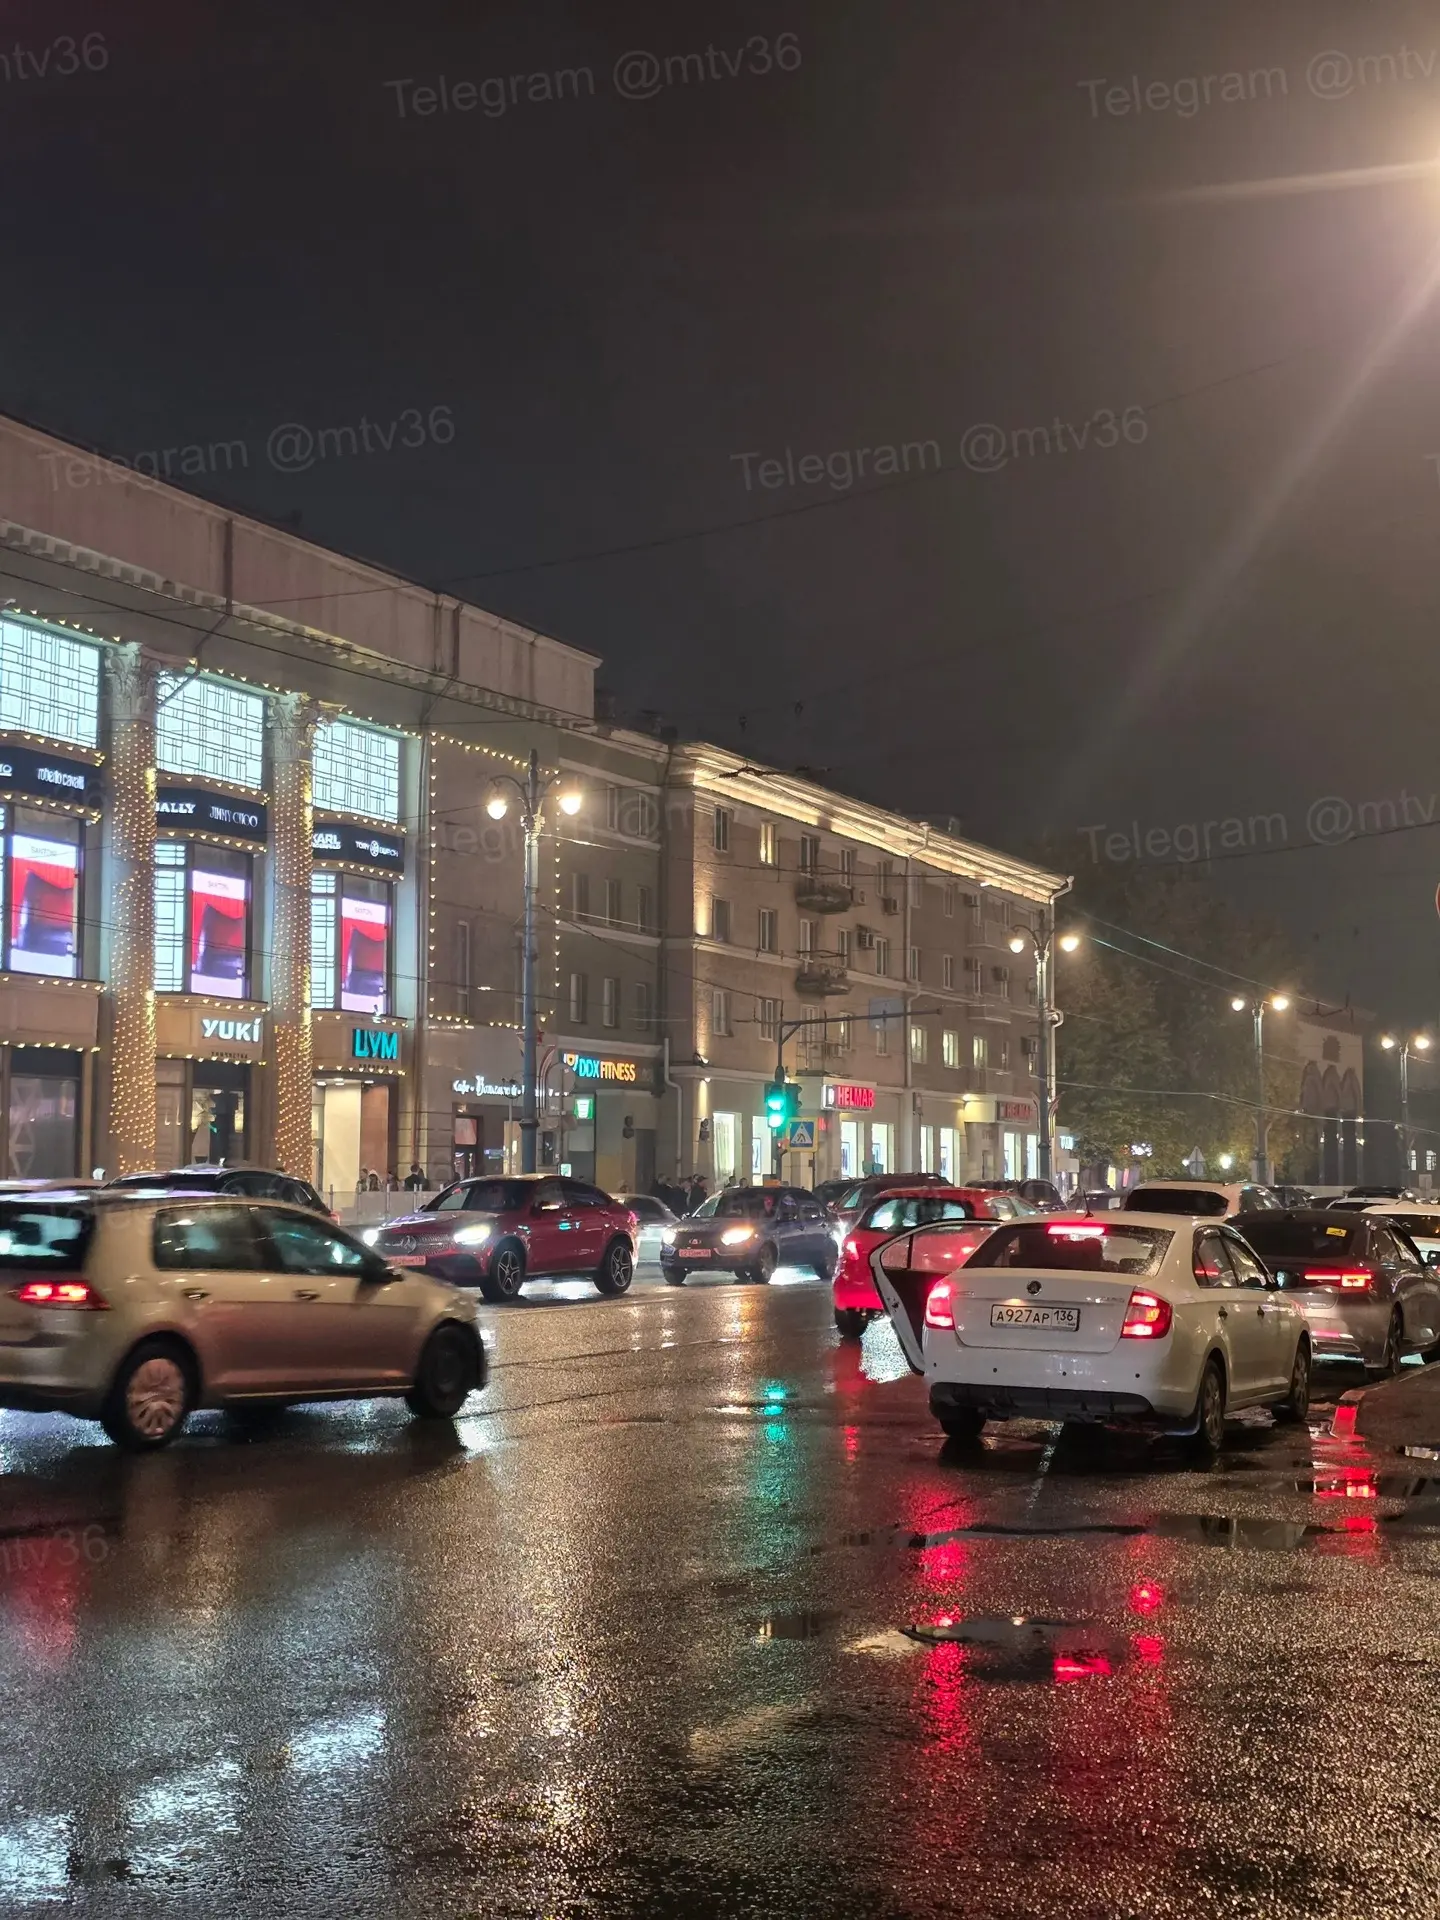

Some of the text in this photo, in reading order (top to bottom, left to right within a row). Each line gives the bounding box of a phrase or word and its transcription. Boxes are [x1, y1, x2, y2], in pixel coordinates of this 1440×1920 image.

[209, 805, 258, 828] JIMMY CHOO
[579, 1058, 636, 1082] DDX FITNESS
[837, 1085, 875, 1108] HELMAR
[1053, 1310, 1075, 1321] 136
